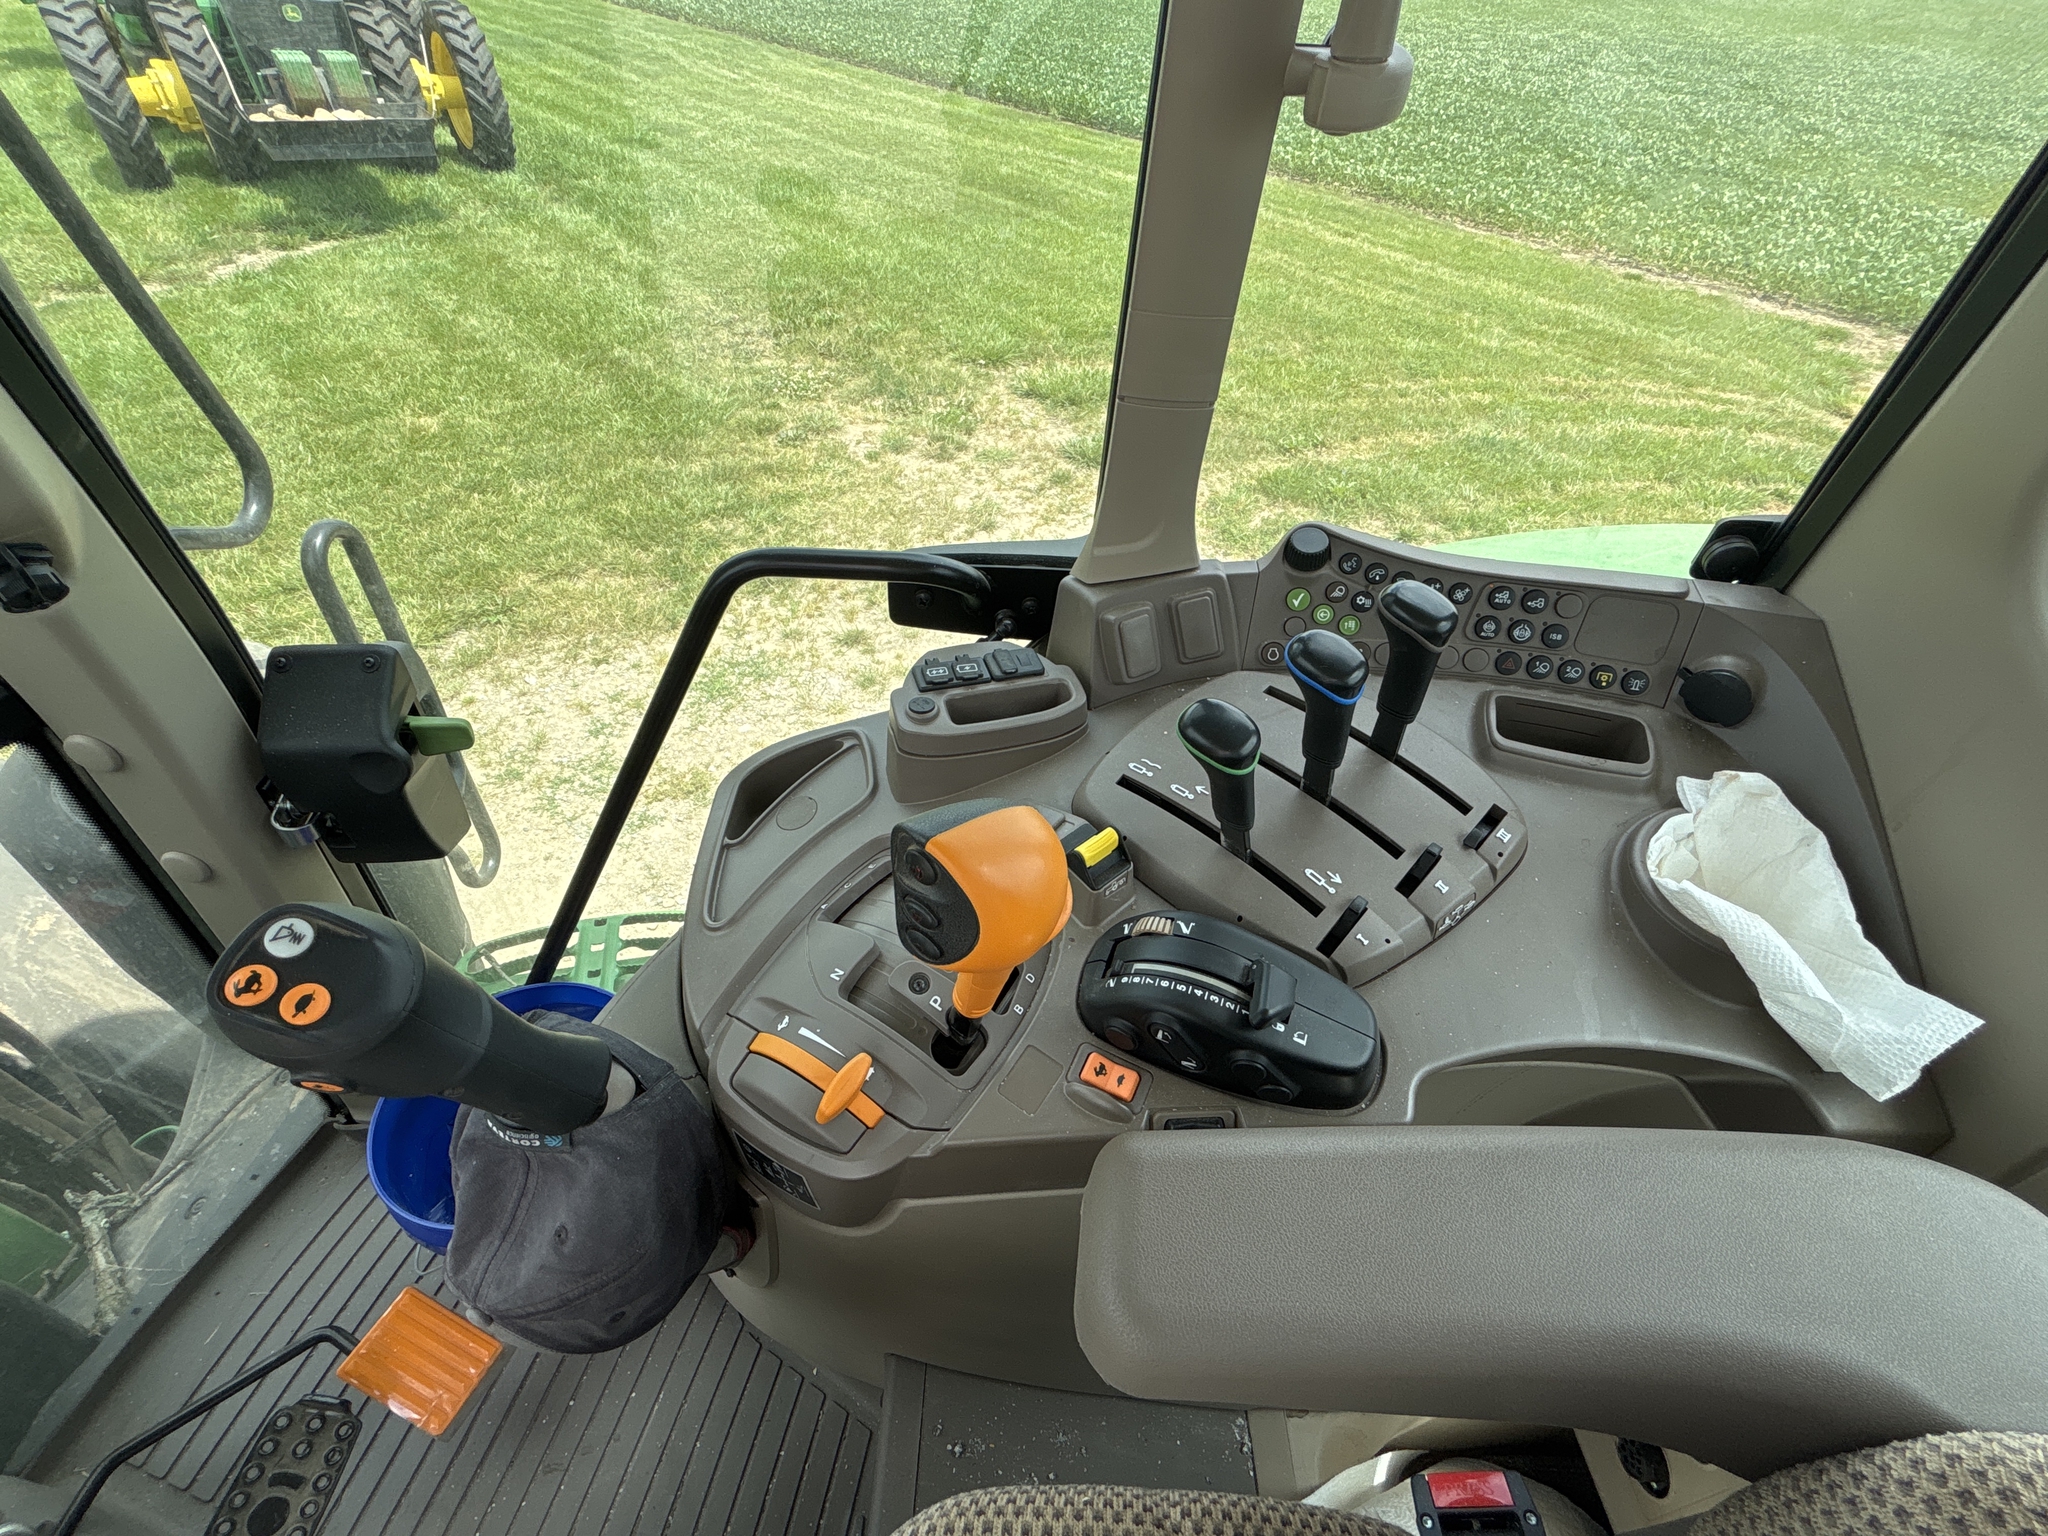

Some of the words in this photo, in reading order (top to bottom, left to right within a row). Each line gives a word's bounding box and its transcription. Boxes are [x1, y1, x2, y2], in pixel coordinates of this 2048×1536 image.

[829, 968, 845, 980] N
[1025, 973, 1035, 983] D
[929, 995, 942, 1011] P
[1013, 1004, 1024, 1015] B
[1444, 1481, 1494, 1496] PRESS
